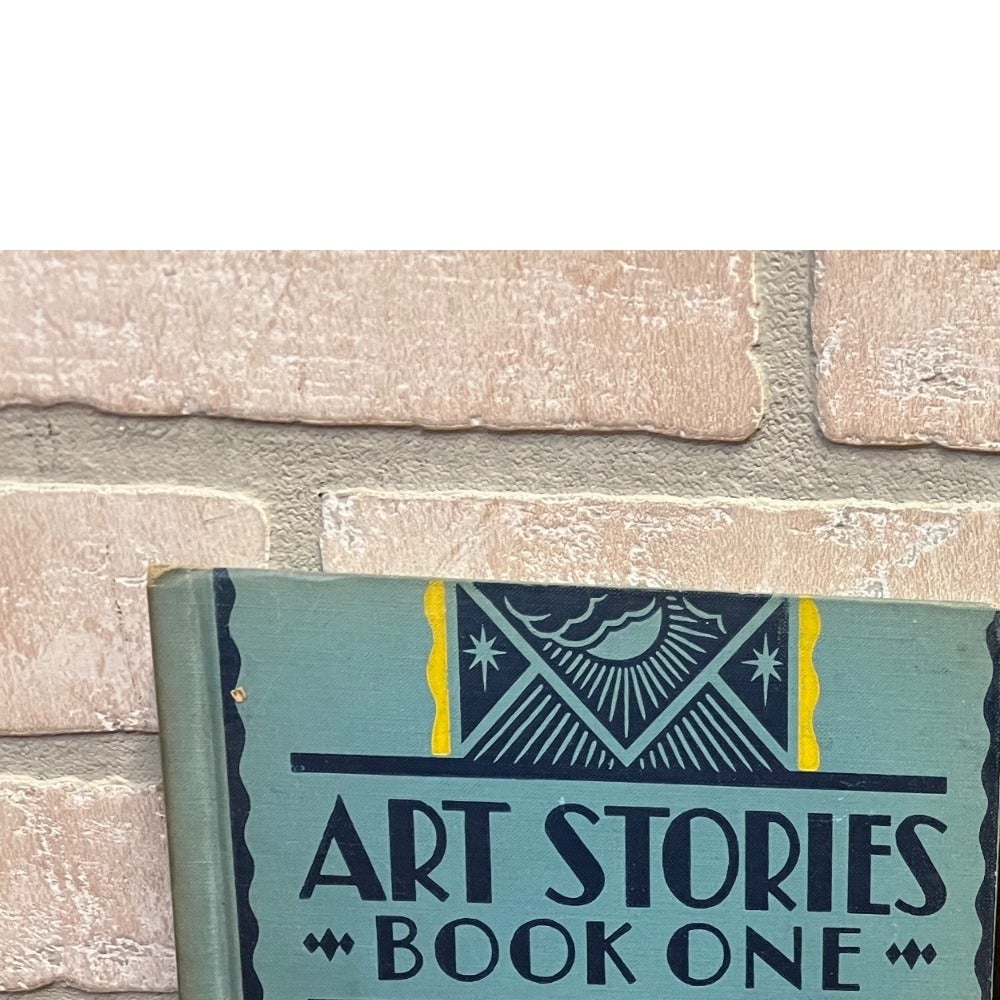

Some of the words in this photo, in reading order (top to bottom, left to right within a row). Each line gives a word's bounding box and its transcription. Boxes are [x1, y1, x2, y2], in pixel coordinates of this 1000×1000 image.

[299, 795, 511, 904] ART
[545, 804, 947, 916] STORIES
[376, 916, 636, 985] BOOK
[667, 922, 861, 991] ONE
